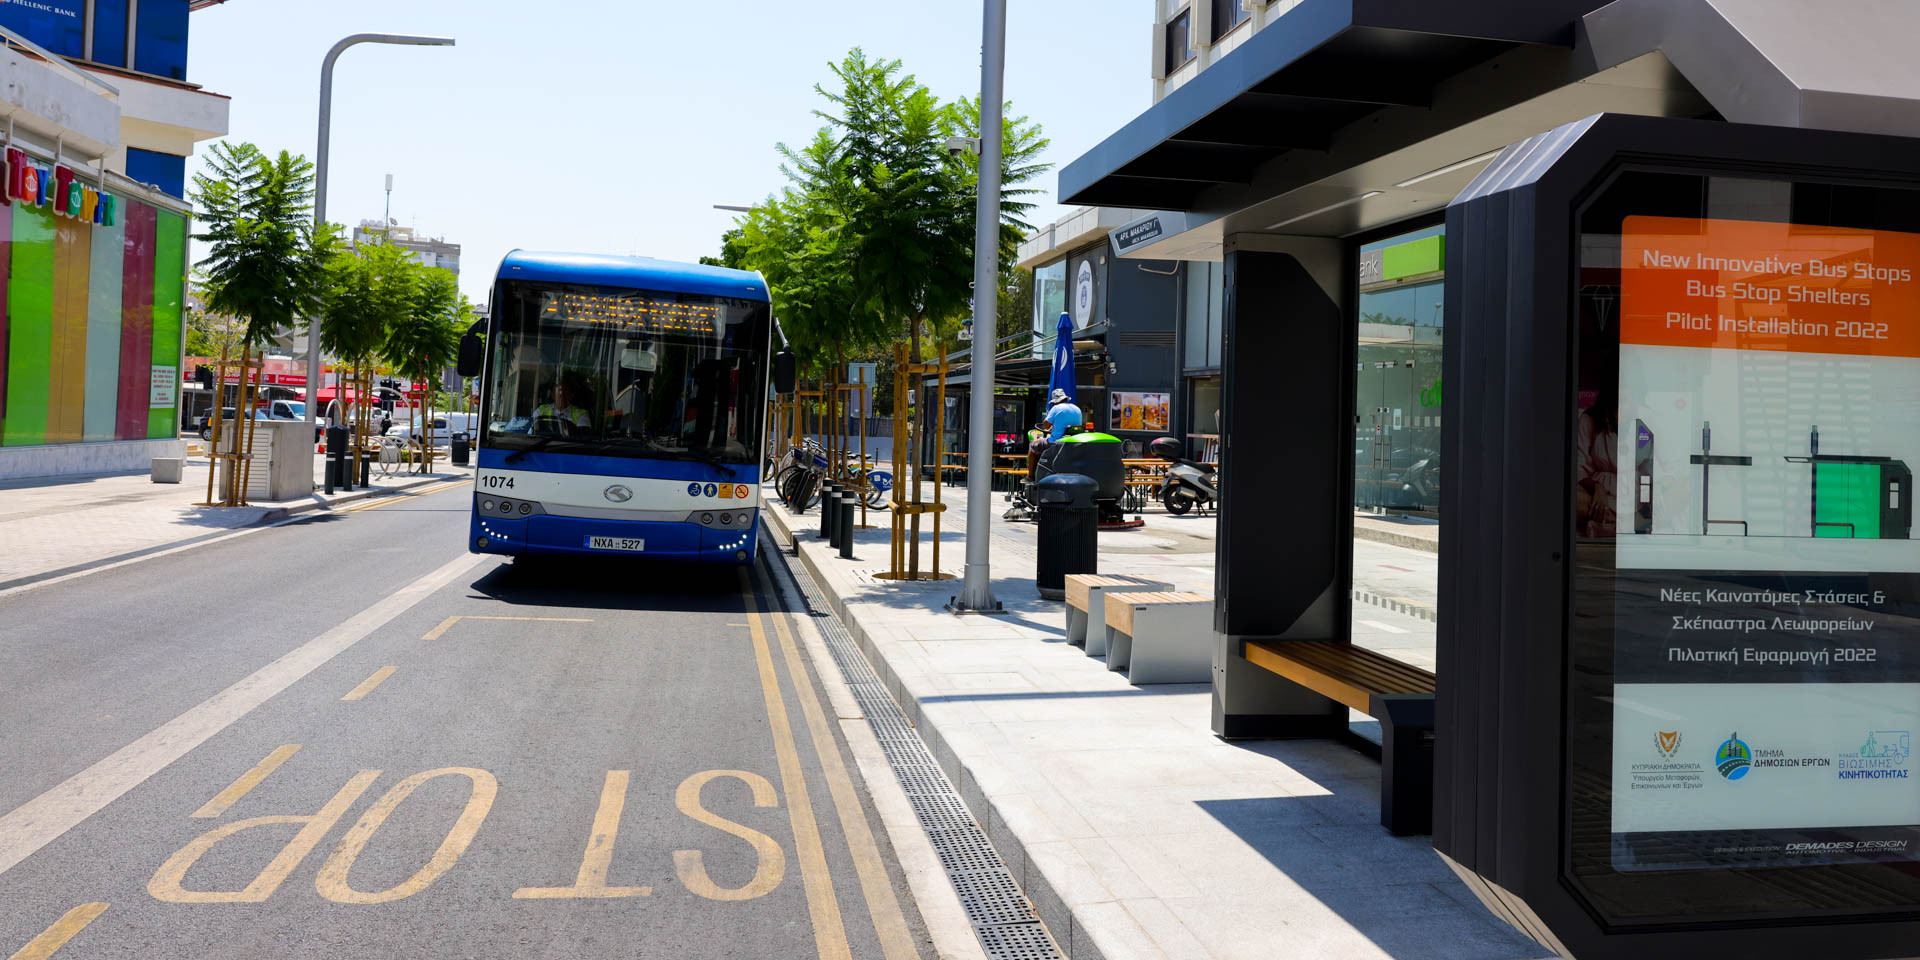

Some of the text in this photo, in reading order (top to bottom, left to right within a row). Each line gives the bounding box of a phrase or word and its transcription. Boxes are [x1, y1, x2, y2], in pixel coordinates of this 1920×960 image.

[13, 0, 76, 17] HELLENIC BANK
[7, 147, 117, 227] TOY TOWER
[1643, 249, 1911, 285] New Innovative Bus Stops
[1687, 279, 1870, 306] Bus Stop Shelters
[1666, 311, 1889, 339] Pilot Installation 2022
[482, 475, 515, 489] 1074
[593, 537, 641, 550] NXA 527
[1660, 588, 1887, 606] Νέες Καινοτόμες Στάσεις &
[1672, 615, 1874, 634] Σκέπαστρα Λεωφορείων
[1668, 647, 1877, 665] Πιλοτική Εφαρμογή 2022
[1754, 749, 1785, 758] ΤΜΗΜΑ
[1754, 758, 1831, 767] ΔΗΜΟΣΙΩΝ ΕΡΓΩΝ
[1839, 759, 1893, 769] ΒΙΩΣΙΜΗΣ
[1838, 769, 1909, 779] ΚΙΝΗΤΙΚΟΤΗΤΑΣ
[146, 766, 786, 904] STOP
[1785, 841, 1855, 851] DEMADES
[1856, 840, 1908, 849] DESIGN
